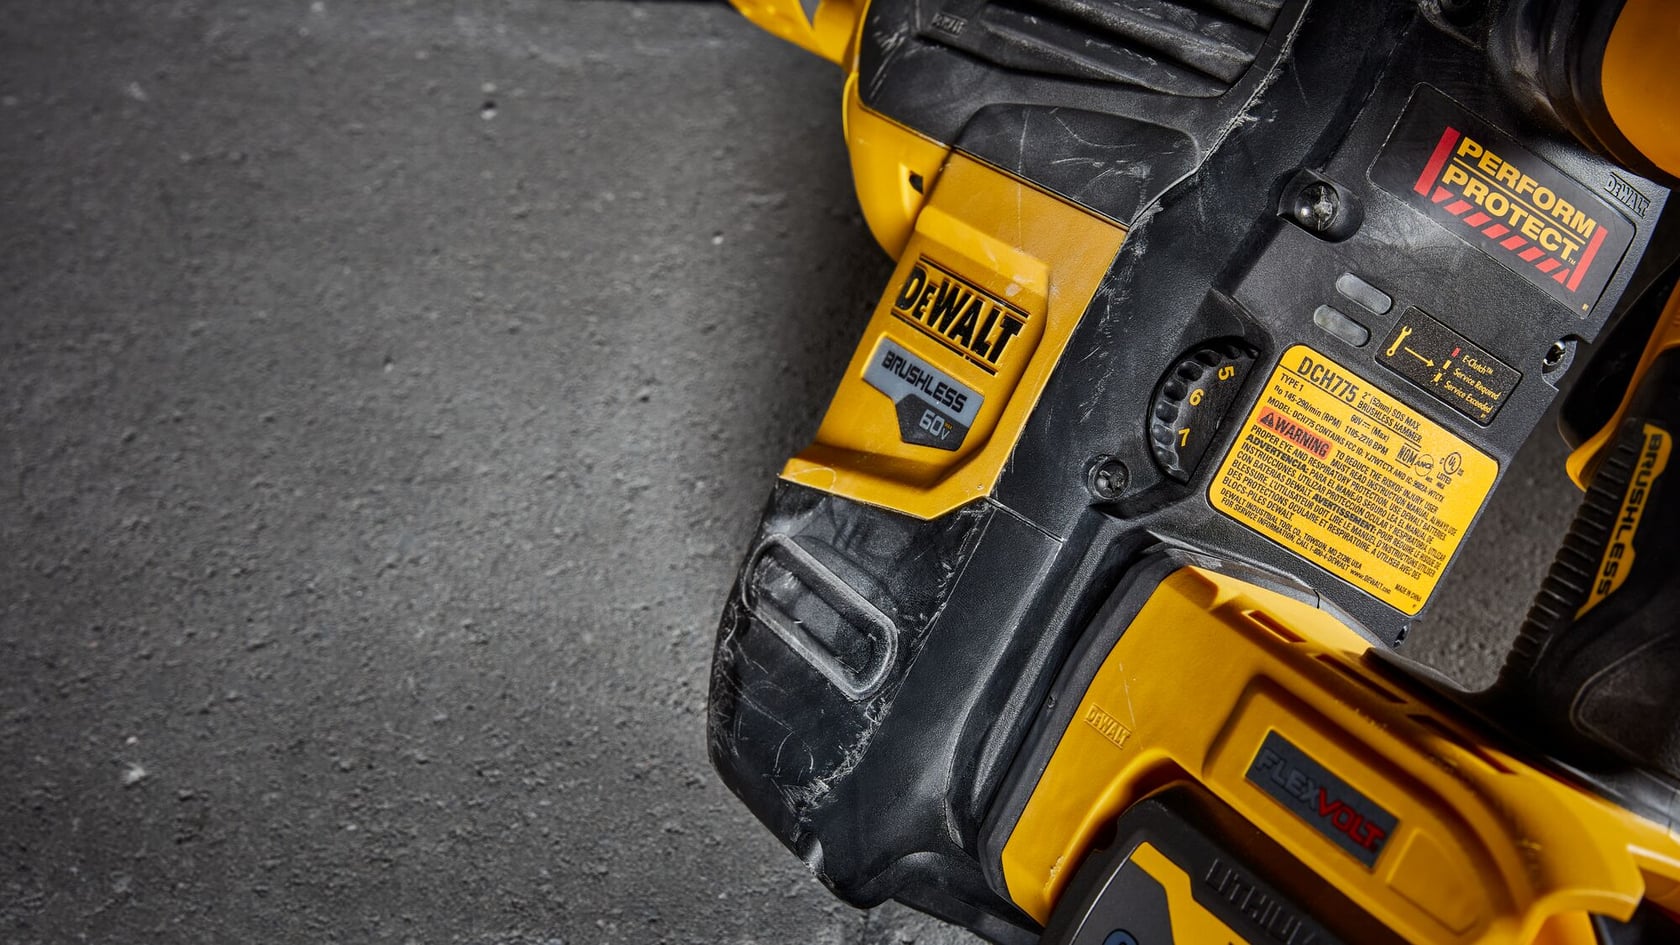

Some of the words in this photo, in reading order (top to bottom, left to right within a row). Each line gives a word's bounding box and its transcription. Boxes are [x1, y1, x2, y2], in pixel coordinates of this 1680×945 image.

[1456, 136, 1597, 238] PERFORM
[881, 349, 967, 413] BRUSHLESS
[1188, 388, 1204, 405] 6
[1218, 366, 1234, 380] 5
[1279, 373, 1299, 388] TYPE
[1295, 355, 1361, 403] DCH775
[1443, 380, 1466, 398] Service
[1465, 393, 1493, 413] Exceeded
[1452, 367, 1476, 386] Service
[1473, 380, 1502, 400] Required
[1178, 429, 1190, 446] 7
[1266, 396, 1292, 415] MODEL:
[1291, 410, 1315, 428] DCH775
[1313, 423, 1345, 445] CONTAINS
[1344, 440, 1357, 452] FCC
[1392, 468, 1406, 480] AND
[1272, 416, 1330, 457] WARNING
[1320, 411, 1342, 429] (RPM)
[1356, 400, 1395, 427] BRUSHLESS
[1392, 421, 1423, 443] HAMMER
[1391, 408, 1405, 421] SDS
[1403, 416, 1421, 430] MAX
[1371, 441, 1389, 455] BPM
[1222, 476, 1267, 505] BLOCS-PILES
[1236, 450, 1253, 464] CON
[1375, 528, 1393, 543] POUR
[1250, 425, 1279, 445] PROPER
[1278, 440, 1293, 453] EYE
[1292, 448, 1308, 461] AND
[1307, 457, 1350, 485] RESPIRATORY
[1388, 503, 1401, 514] USE
[1400, 509, 1424, 527] DEWALT
[1330, 458, 1350, 474] MUST
[1348, 469, 1367, 484] READ
[1365, 479, 1407, 507] INSTRUCTION
[1335, 450, 1346, 460] TO
[1343, 455, 1370, 474] REDUCE
[1368, 469, 1382, 481] THE
[1423, 501, 1439, 514] USER
[1221, 496, 1233, 507] FOR
[1232, 503, 1256, 520] SERVICE
[1295, 537, 1309, 549] CALL
[1226, 467, 1242, 481] DES
[1241, 476, 1288, 506] PROTECTIONS
[1287, 501, 1319, 523] OCULAIRE
[1317, 518, 1328, 528] ET
[1375, 550, 1400, 569] UTILISER
[1398, 563, 1412, 575] AVEC
[1296, 473, 1326, 494] UTILIZAR
[1363, 510, 1389, 529] OCULAR
[1387, 523, 1394, 532] Y
[1308, 468, 1327, 483] PARA
[1326, 478, 1336, 488] EL
[1334, 483, 1363, 503] MANEJO
[1360, 498, 1387, 517] SEGURO
[1385, 512, 1399, 524] LEA
[1397, 518, 1406, 528] EL
[1404, 523, 1427, 540] MANUAL
[1313, 504, 1329, 518] DOIT
[1328, 513, 1343, 526] LIRE
[1342, 521, 1351, 530] LE
[1350, 525, 1377, 545] MANUEL
[1596, 434, 1663, 595] BRUSHLESS
[1220, 487, 1246, 505] DEWALT
[1245, 501, 1279, 524] INDUSTRIAL
[1278, 519, 1293, 531] TOOL
[1327, 546, 1338, 556] MD
[1350, 559, 1362, 570] USA
